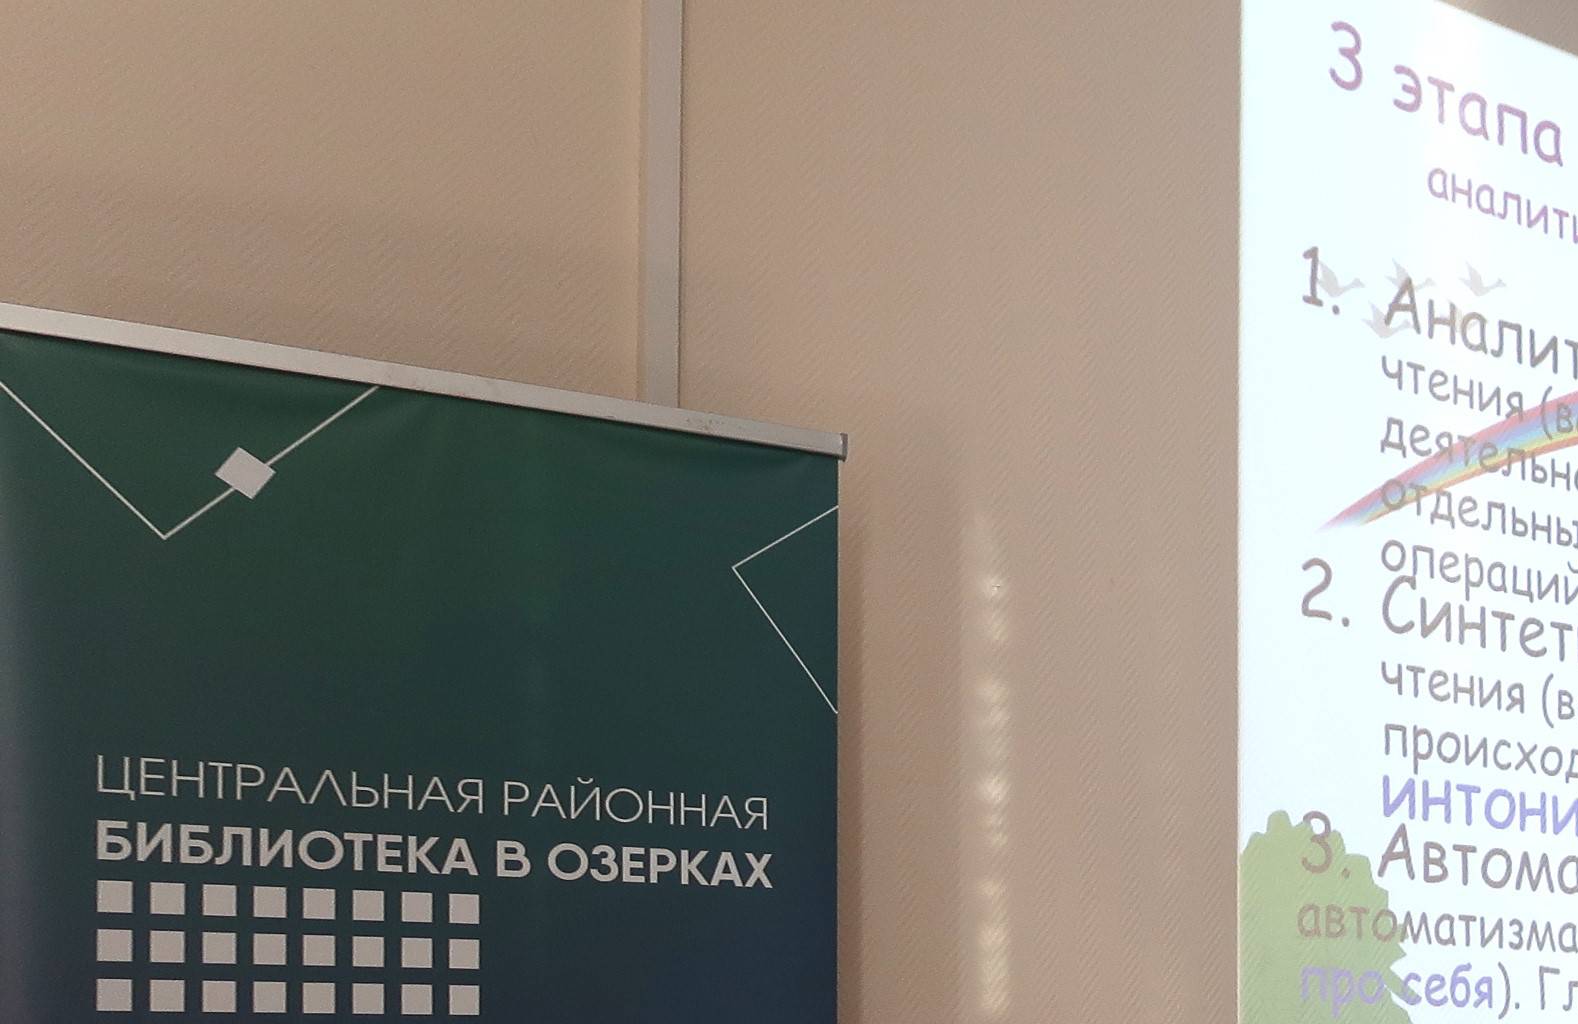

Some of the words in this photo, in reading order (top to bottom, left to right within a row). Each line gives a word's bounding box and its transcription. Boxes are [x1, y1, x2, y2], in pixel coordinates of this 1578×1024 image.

[1328, 20, 1365, 91] 3
[1391, 65, 1563, 165] этапа
[1300, 246, 1341, 315] 1.
[1381, 355, 1524, 417] чтения
[1300, 557, 1351, 627] 2.
[1380, 661, 1526, 713] чтения
[97, 754, 484, 814] ЦЕНТРАЛЬНАЯ
[503, 776, 769, 831] РАЙОННАЯ
[97, 819, 479, 876] БИБЛИОТЕКА
[496, 840, 531, 878] В
[547, 842, 774, 889] ОЗЕРКАХ
[1299, 810, 1352, 877] 3.
[1296, 909, 1578, 952] автоматизма
[1299, 969, 1386, 1018] про
[1399, 963, 1521, 1019] себя).
